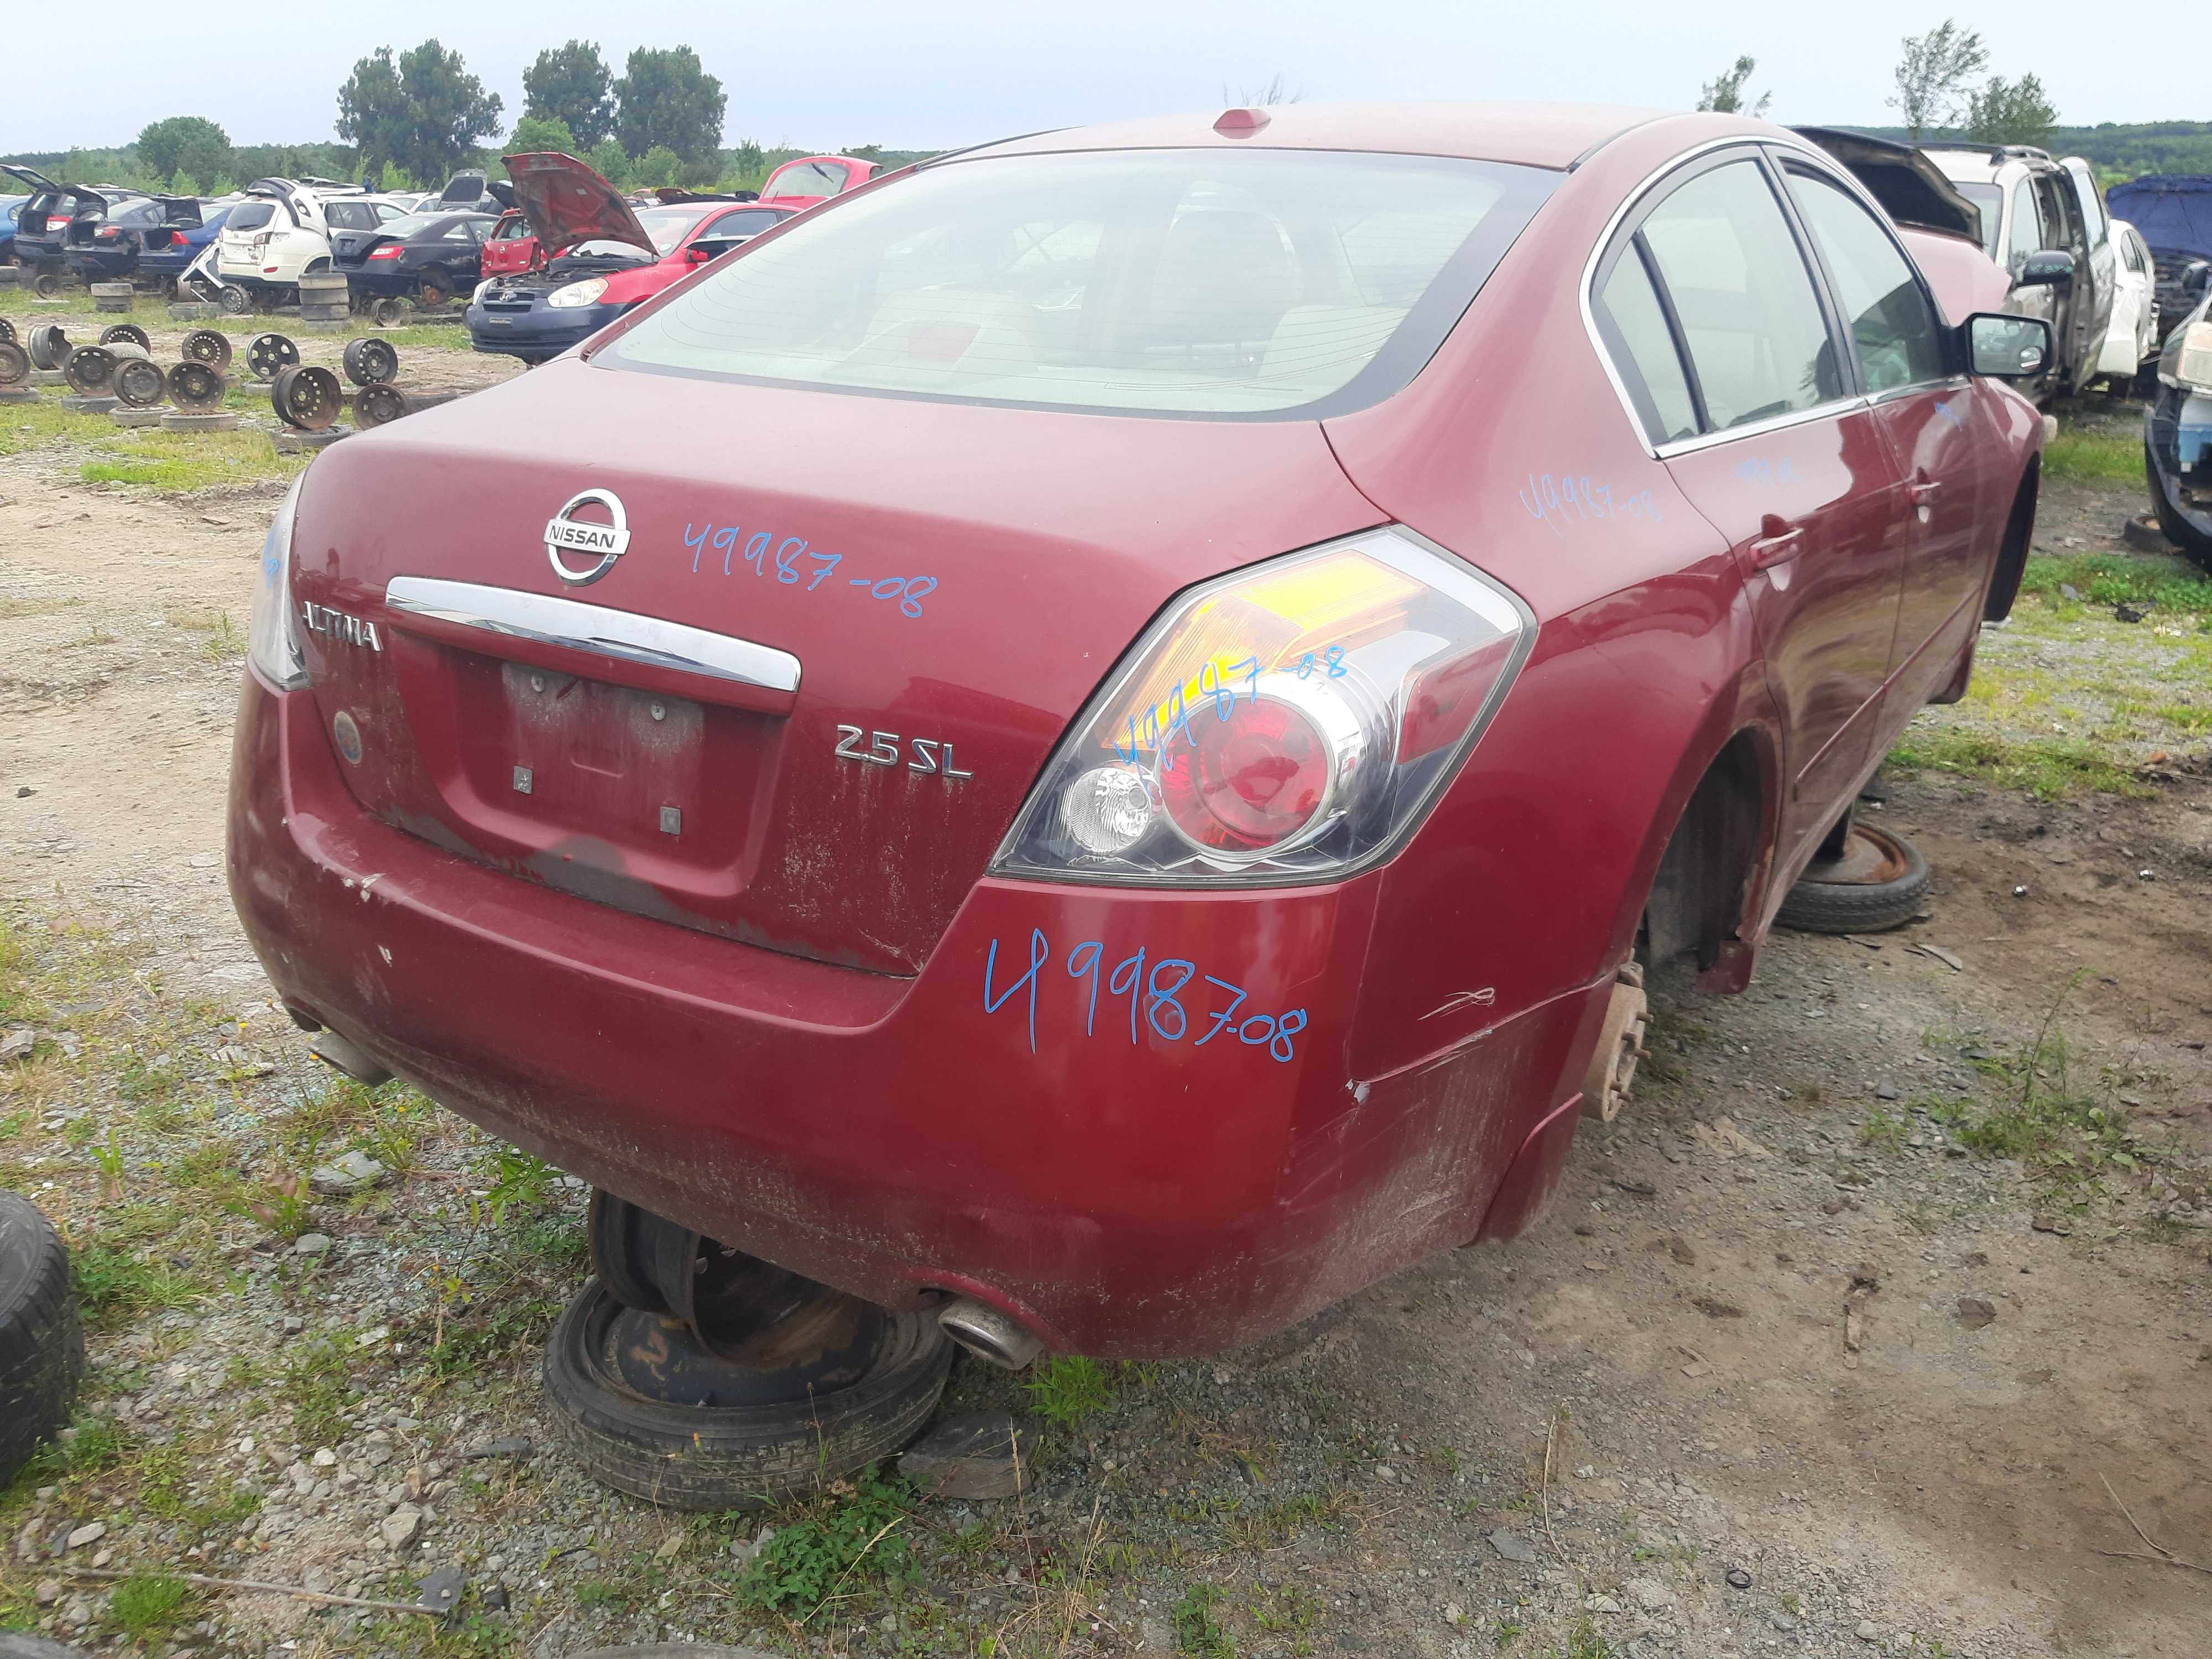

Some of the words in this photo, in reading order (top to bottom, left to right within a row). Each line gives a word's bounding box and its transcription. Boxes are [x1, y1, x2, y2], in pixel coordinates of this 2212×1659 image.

[549, 525, 616, 549] NISSAN
[684, 522, 938, 618] 49987-08
[302, 601, 383, 652] ALTIMA
[907, 738, 973, 779] SL
[1114, 645, 1348, 803] 49987-08
[984, 928, 1307, 1062] 49987-08
